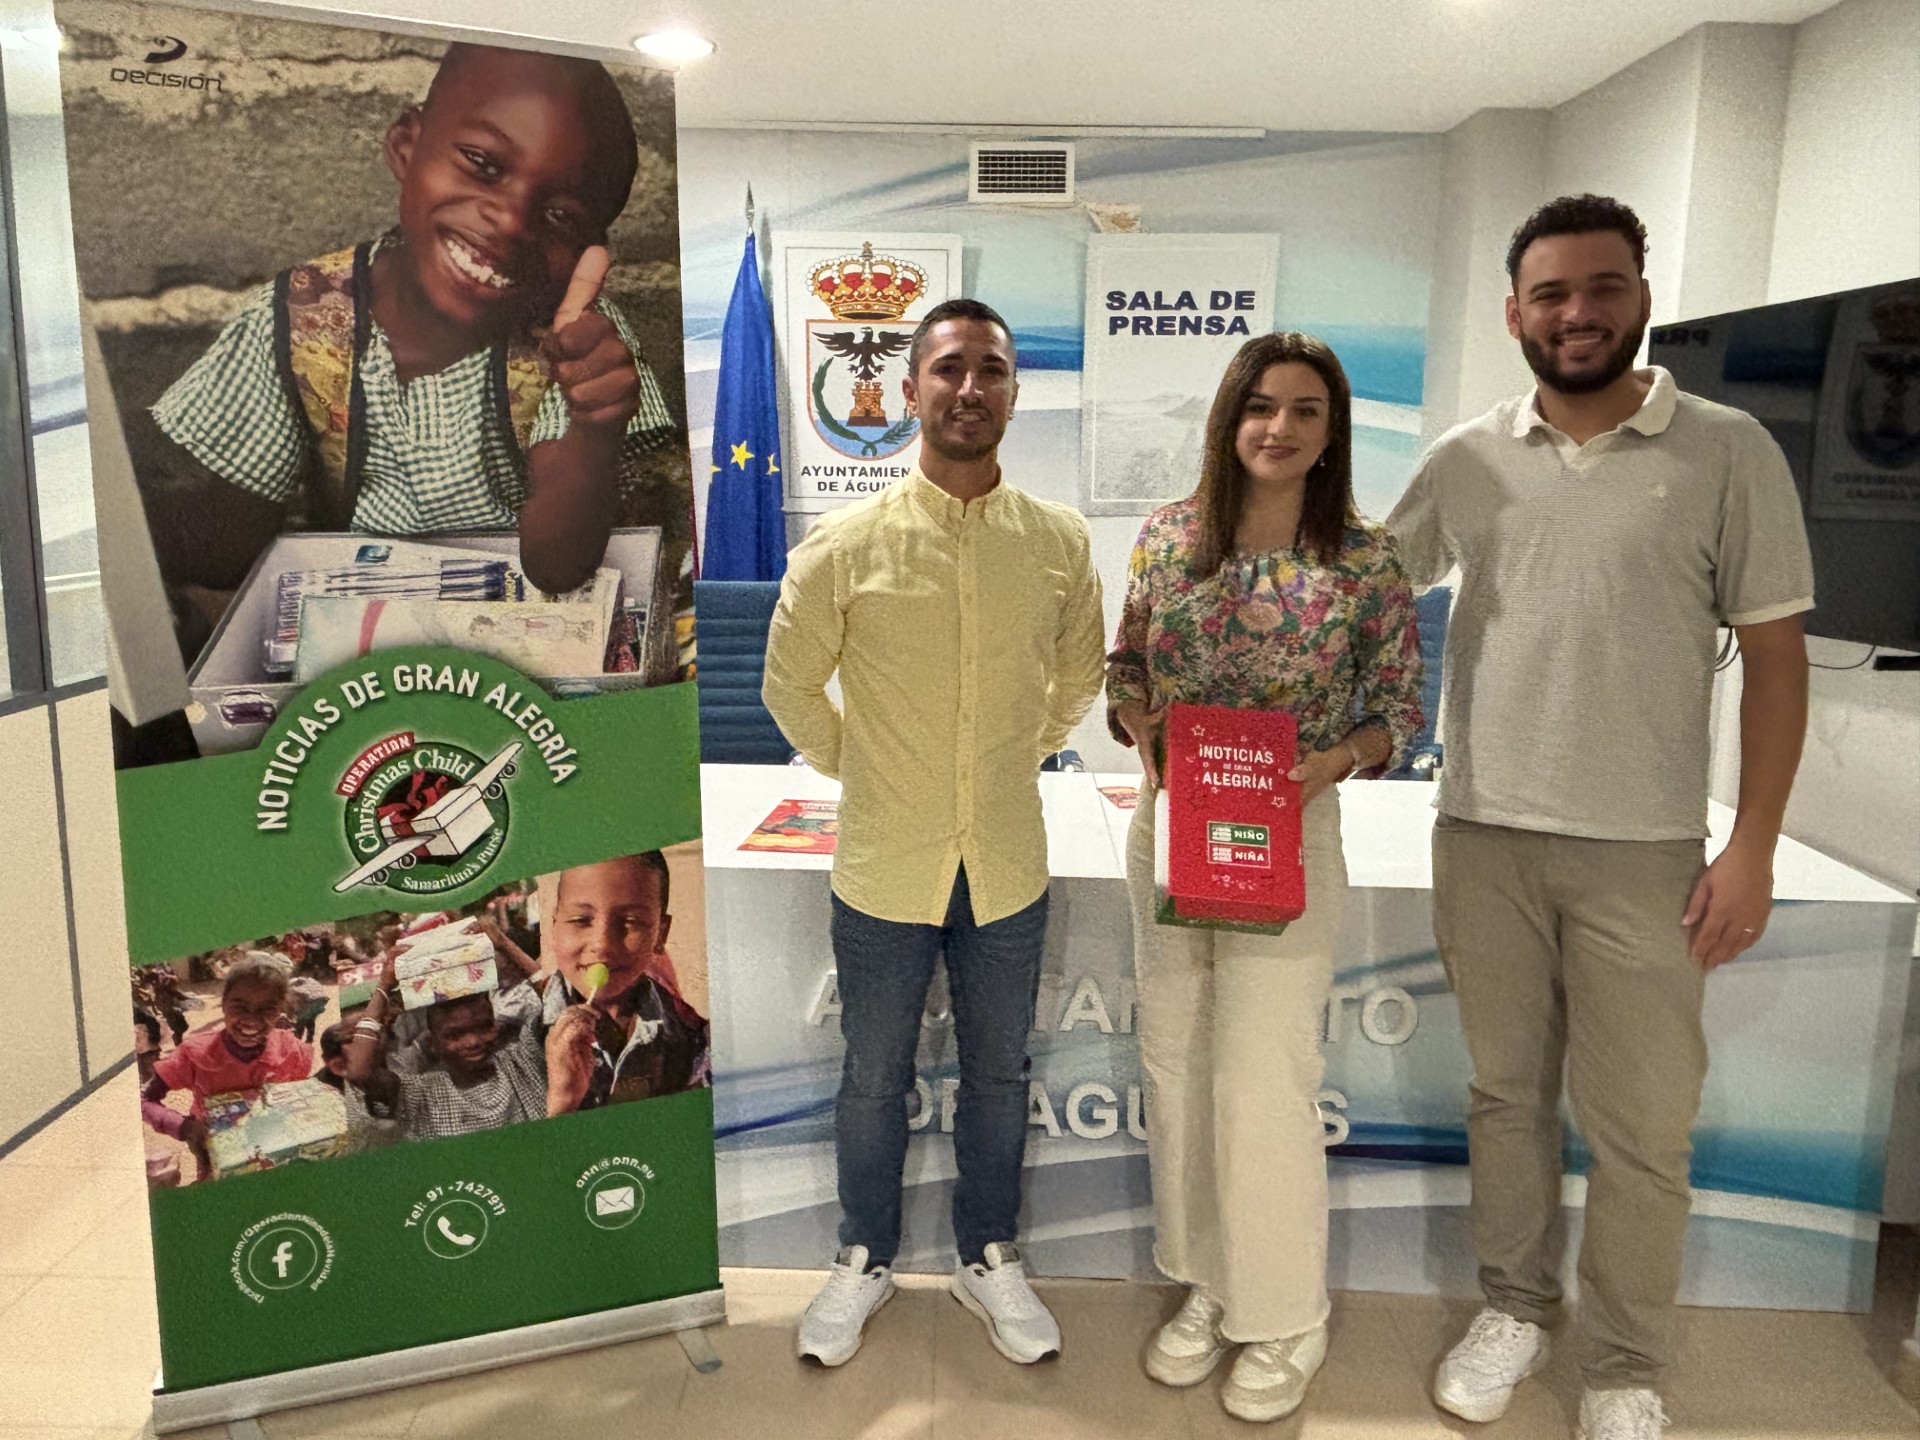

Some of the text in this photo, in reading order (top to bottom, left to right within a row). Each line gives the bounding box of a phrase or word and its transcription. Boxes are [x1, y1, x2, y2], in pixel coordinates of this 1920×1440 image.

[1106, 291, 1256, 310] SALA DE
[1108, 316, 1251, 335] PRENSA
[801, 466, 911, 477] AYUNTAMIEN
[818, 480, 892, 492] DE ÁGUI
[257, 664, 578, 830] NOTICIAS DE GRAN ALEGRÍA
[341, 735, 411, 794] OPERATION
[1203, 771, 1273, 791] ALEGRÍA!
[355, 749, 476, 853] Christmas Child
[1234, 829, 1265, 841] NIÑO
[1235, 851, 1265, 862] NIÑA
